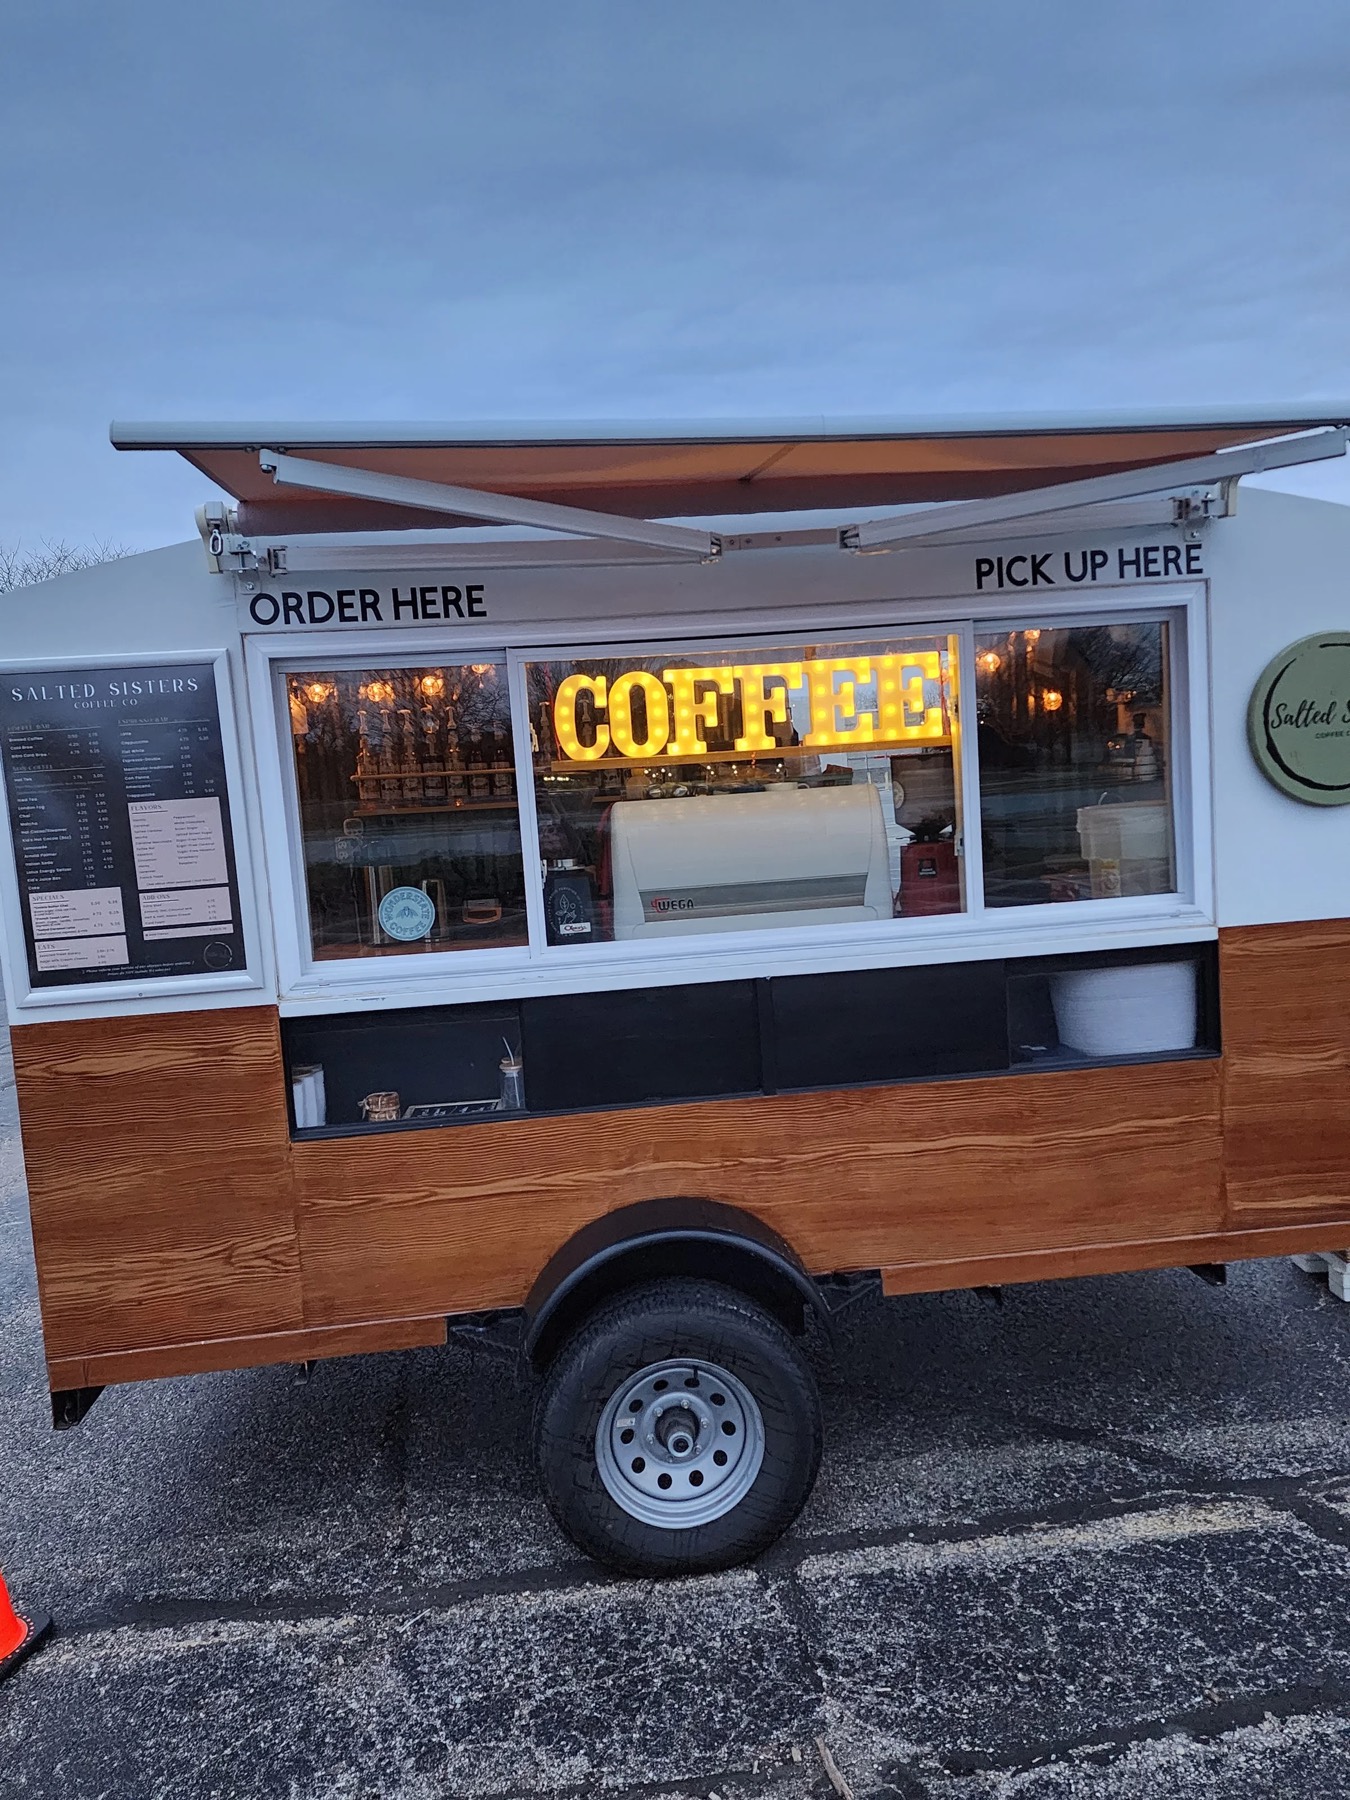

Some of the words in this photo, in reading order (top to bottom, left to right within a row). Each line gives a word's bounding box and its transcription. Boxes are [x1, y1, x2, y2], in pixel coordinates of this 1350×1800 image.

[975, 553, 1056, 590] PICK
[1064, 549, 1109, 583] UP
[1117, 543, 1204, 579] HERE
[249, 587, 382, 626] ORDER
[391, 584, 488, 621] HERE
[11, 683, 95, 702] SALTED
[109, 677, 199, 696] SISTERS
[74, 699, 117, 709] COFFEE
[122, 698, 138, 707] CO
[554, 650, 943, 761] COFFEE
[1271, 699, 1337, 729] Salted
[1315, 731, 1344, 740] COFFEE
[384, 891, 430, 922] WONDERSTATE
[657, 899, 694, 911] WEGA
[390, 921, 427, 936] COFFEE
